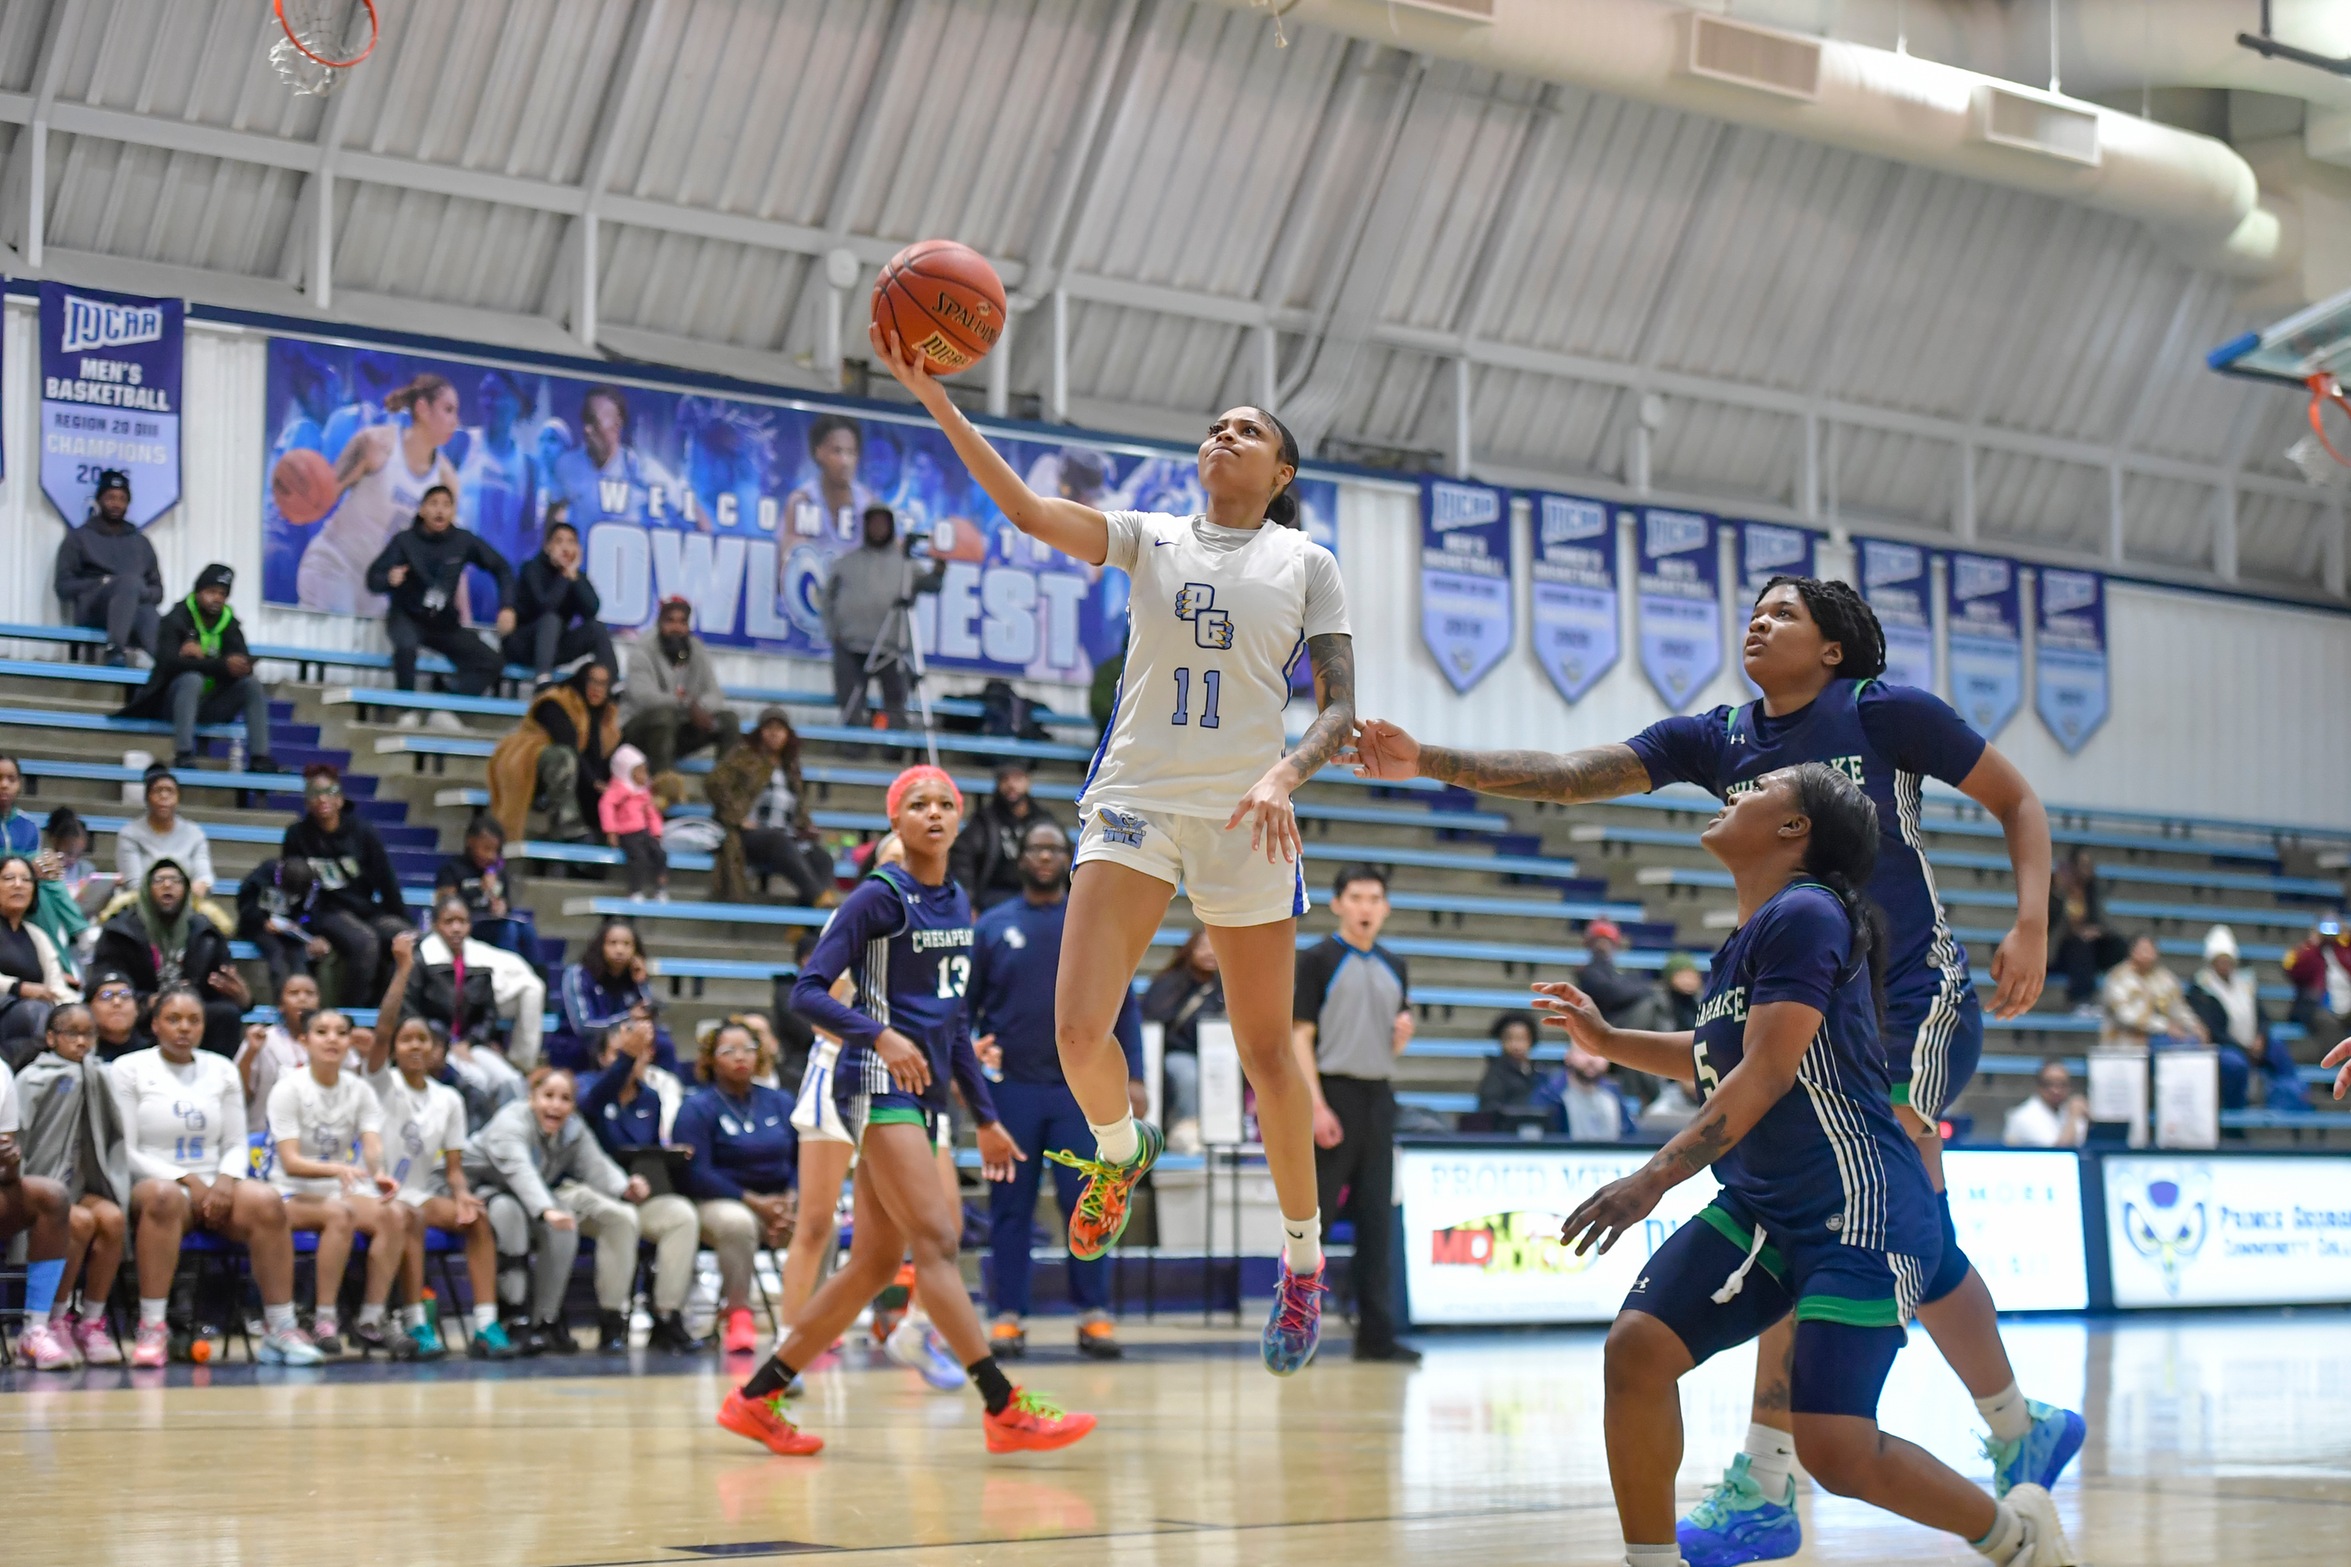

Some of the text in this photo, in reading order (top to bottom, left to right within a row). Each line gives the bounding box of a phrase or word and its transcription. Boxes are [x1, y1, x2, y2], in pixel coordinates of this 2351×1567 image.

[68, 301, 158, 345] NJCAA
[931, 291, 1000, 345] SPALDIN
[79, 356, 143, 386] MEN'S
[45, 376, 171, 412] BASKETBALL
[54, 411, 108, 433] REGION
[46, 433, 168, 465] CHAMPIONS
[599, 479, 854, 541] WELCOME
[914, 559, 1089, 669] EST
[1176, 582, 1233, 650] PG
[1171, 667, 1220, 729] 11
[912, 928, 974, 953] CHESAPEA
[937, 955, 971, 999] 13
[1693, 1040, 1720, 1102] 5
[1431, 1164, 1545, 1196] PROUD
